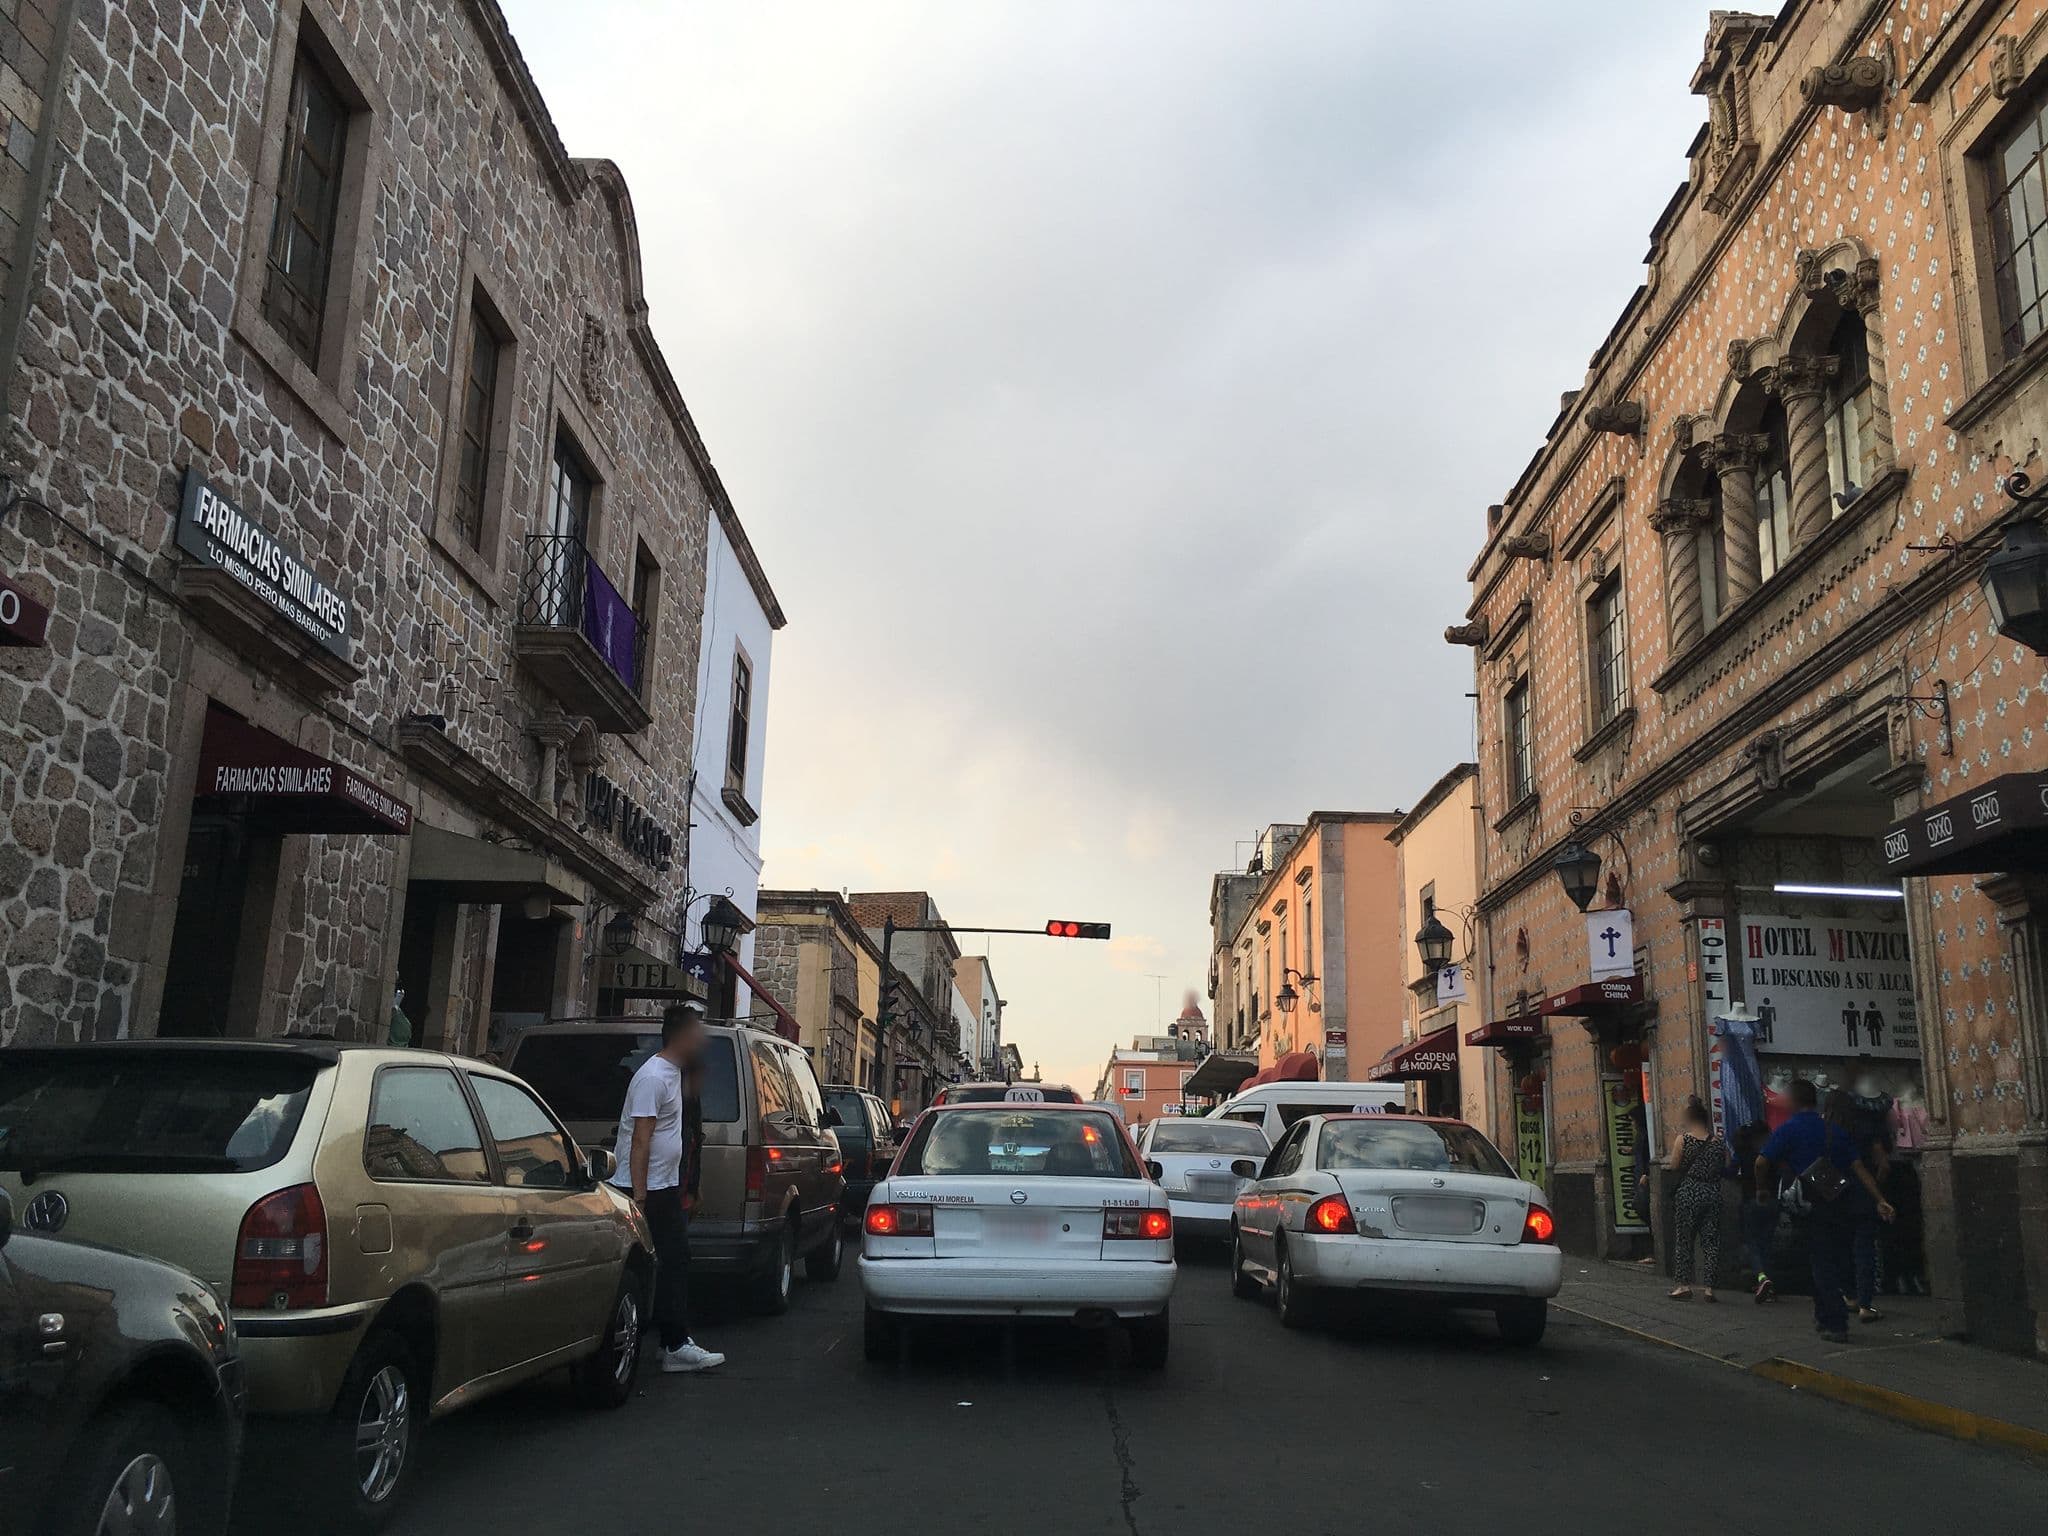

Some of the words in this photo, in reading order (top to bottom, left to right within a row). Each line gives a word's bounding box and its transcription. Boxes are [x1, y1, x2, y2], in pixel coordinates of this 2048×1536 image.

[193, 486, 281, 583] FARMACIAS
[282, 555, 346, 634] SIMILARES
[224, 556, 254, 586] MISMO
[254, 578, 278, 604] PERO
[278, 595, 296, 618] MAS
[215, 766, 275, 792] FARMACIAS
[277, 766, 332, 793] SIMILARES
[345, 776, 380, 810] FARMACIAS
[378, 794, 407, 826] SIMILARES
[1972, 797, 1999, 824] OXXO
[1927, 816, 1953, 842] OXXO
[1884, 833, 1909, 858] OXXO
[1747, 925, 1816, 959] HOTEL
[1701, 919, 1724, 1000] HOTEL
[1601, 983, 1632, 992] COMIDA
[1752, 968, 1768, 985] EL
[1772, 968, 1840, 989] DESCANSO
[1844, 972, 1854, 989] A
[1856, 973, 1873, 990] SU
[1878, 973, 1913, 991] ALCA
[1604, 991, 1629, 999] CHINA
[1410, 1061, 1451, 1071] MODAS
[1414, 1052, 1457, 1062] CADENA
[1011, 1092, 1038, 1102] TAXI
[1356, 1106, 1382, 1114] TAXI
[1615, 1113, 1634, 1156] CHINA
[1528, 1169, 1539, 1181] Y
[895, 1190, 928, 1198] TSURU
[929, 1195, 945, 1203] TAXI
[945, 1196, 974, 1204] MORELIA
